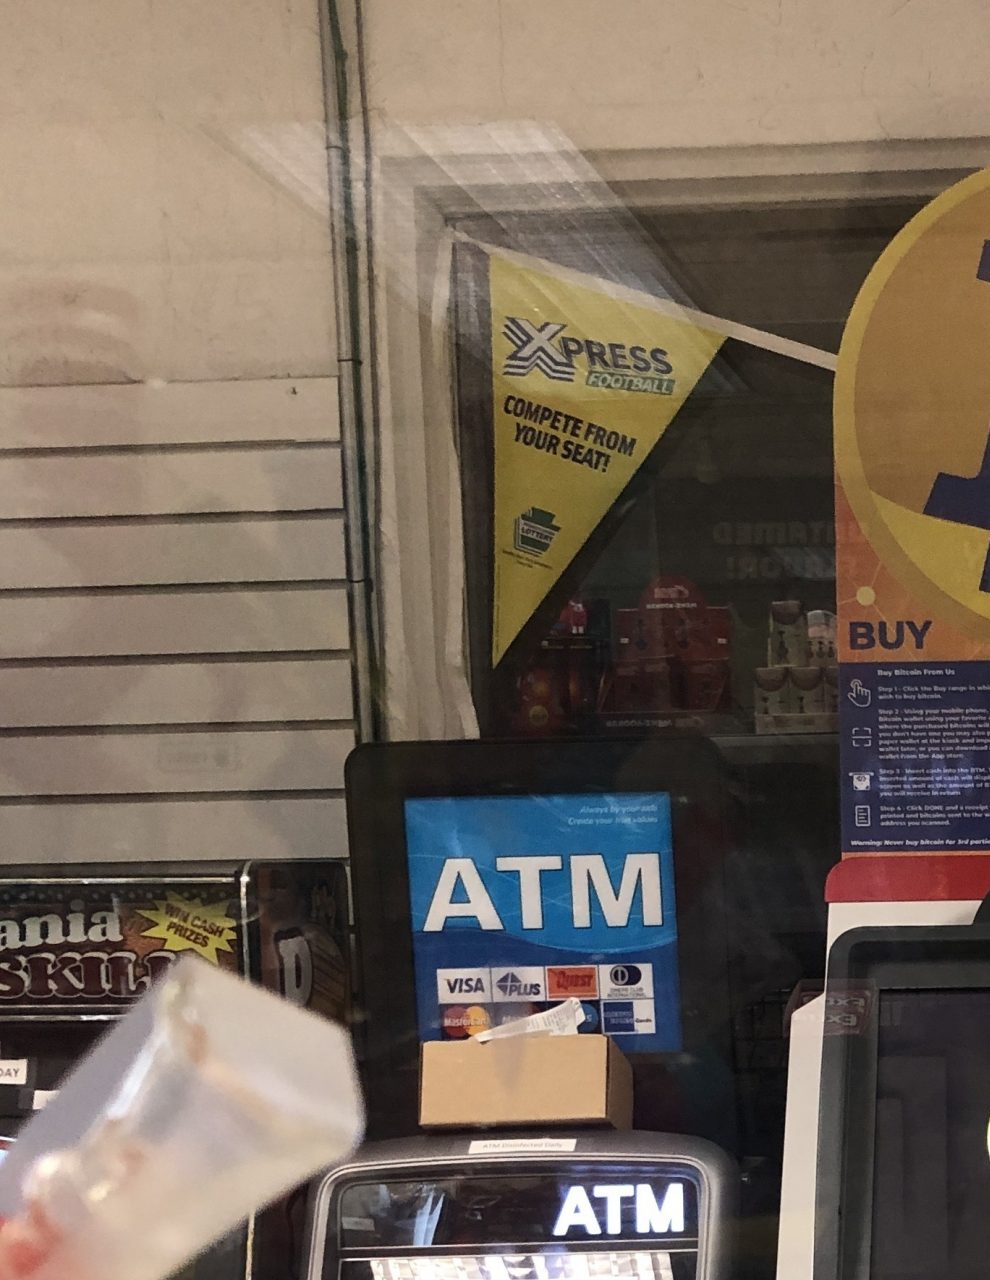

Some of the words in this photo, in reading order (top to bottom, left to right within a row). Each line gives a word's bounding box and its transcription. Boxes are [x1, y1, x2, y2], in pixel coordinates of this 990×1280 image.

[502, 316, 673, 382] XPRESS
[586, 372, 675, 394] FOOTBALL
[504, 395, 583, 439] COMPETE
[583, 428, 637, 457] FROM
[514, 422, 560, 454] YOUR
[561, 440, 611, 472] SEAT!
[849, 621, 933, 650] BUY
[850, 839, 882, 847] Warning:
[905, 838, 918, 846] buy
[422, 853, 663, 932] ATM
[164, 903, 190, 921] WIN
[191, 916, 225, 938] CASH
[166, 922, 210, 948] PRIZES
[446, 978, 485, 993] VISA
[508, 983, 540, 997] PLUS
[553, 1183, 685, 1235] ATM
